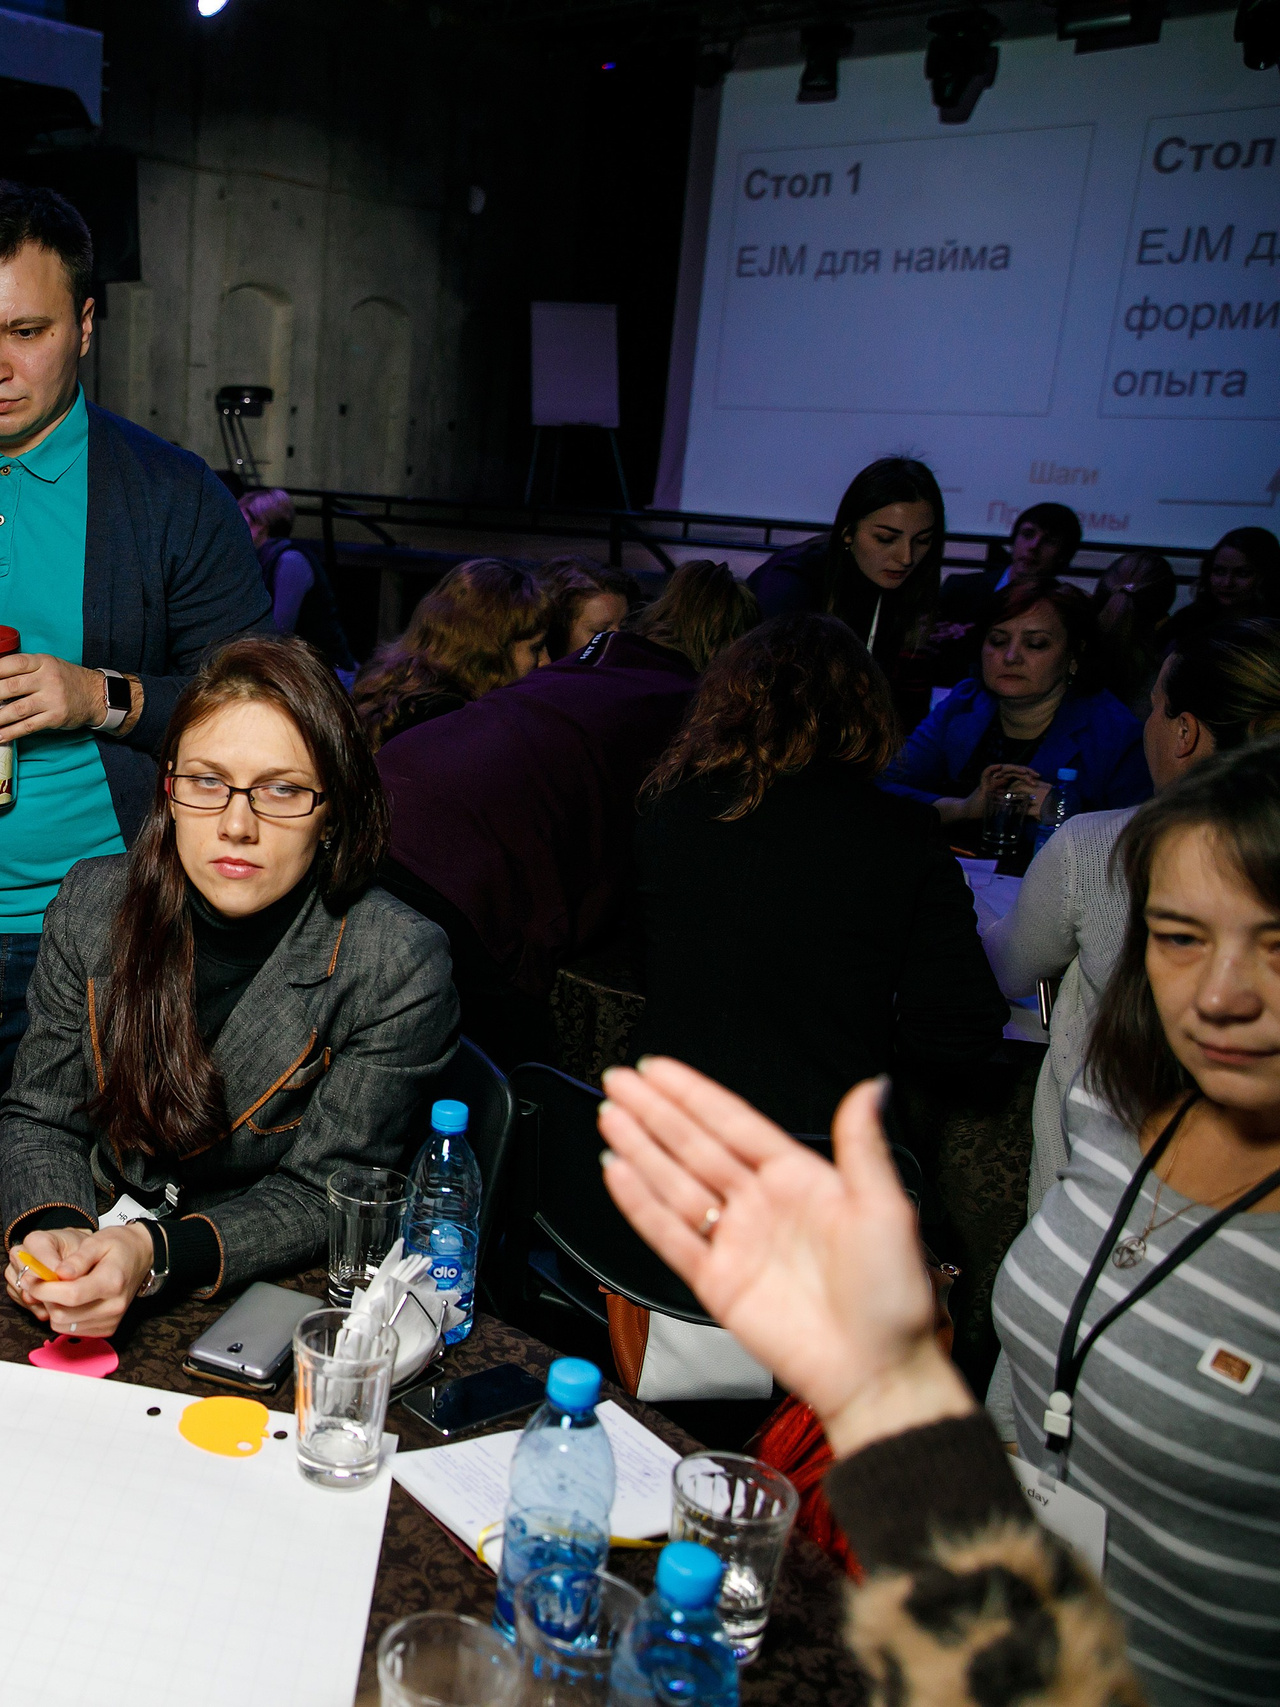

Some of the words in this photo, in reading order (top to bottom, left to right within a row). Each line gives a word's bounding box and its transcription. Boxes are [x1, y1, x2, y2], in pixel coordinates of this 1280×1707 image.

[1153, 136, 1277, 175] Стол
[744, 168, 833, 201] Стол
[846, 162, 862, 195] 1
[735, 244, 808, 279] EJM
[814, 249, 881, 282] для
[892, 239, 1012, 274] найма
[1135, 224, 1235, 266] EJM
[1112, 368, 1248, 399] опыта
[1028, 460, 1099, 486] Шаги
